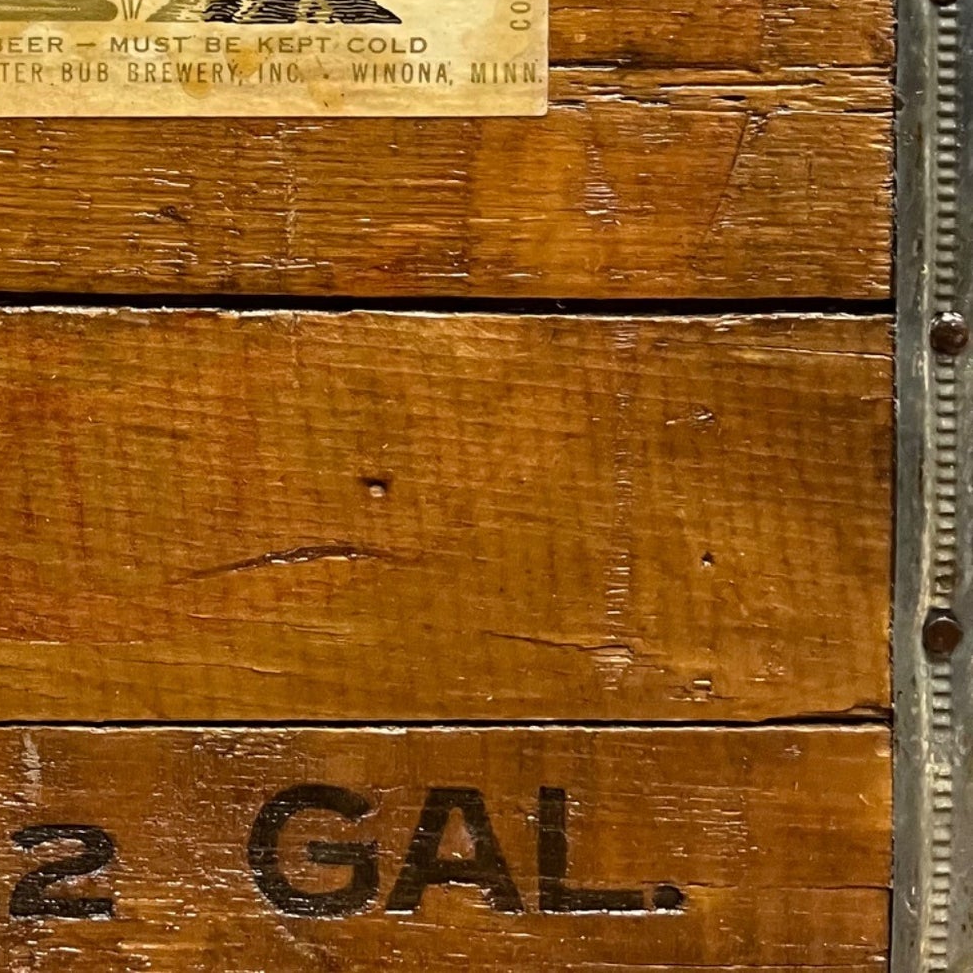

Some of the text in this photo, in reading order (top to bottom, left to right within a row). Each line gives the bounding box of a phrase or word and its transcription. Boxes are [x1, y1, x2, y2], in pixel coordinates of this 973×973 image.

[110, 36, 185, 54] MUST
[205, 36, 241, 54] BE
[258, 36, 329, 54] KEPT
[347, 36, 428, 54] COLD
[61, 62, 109, 84] BUB
[470, 62, 543, 85] MINN.
[246, 783, 686, 917] GAL.
